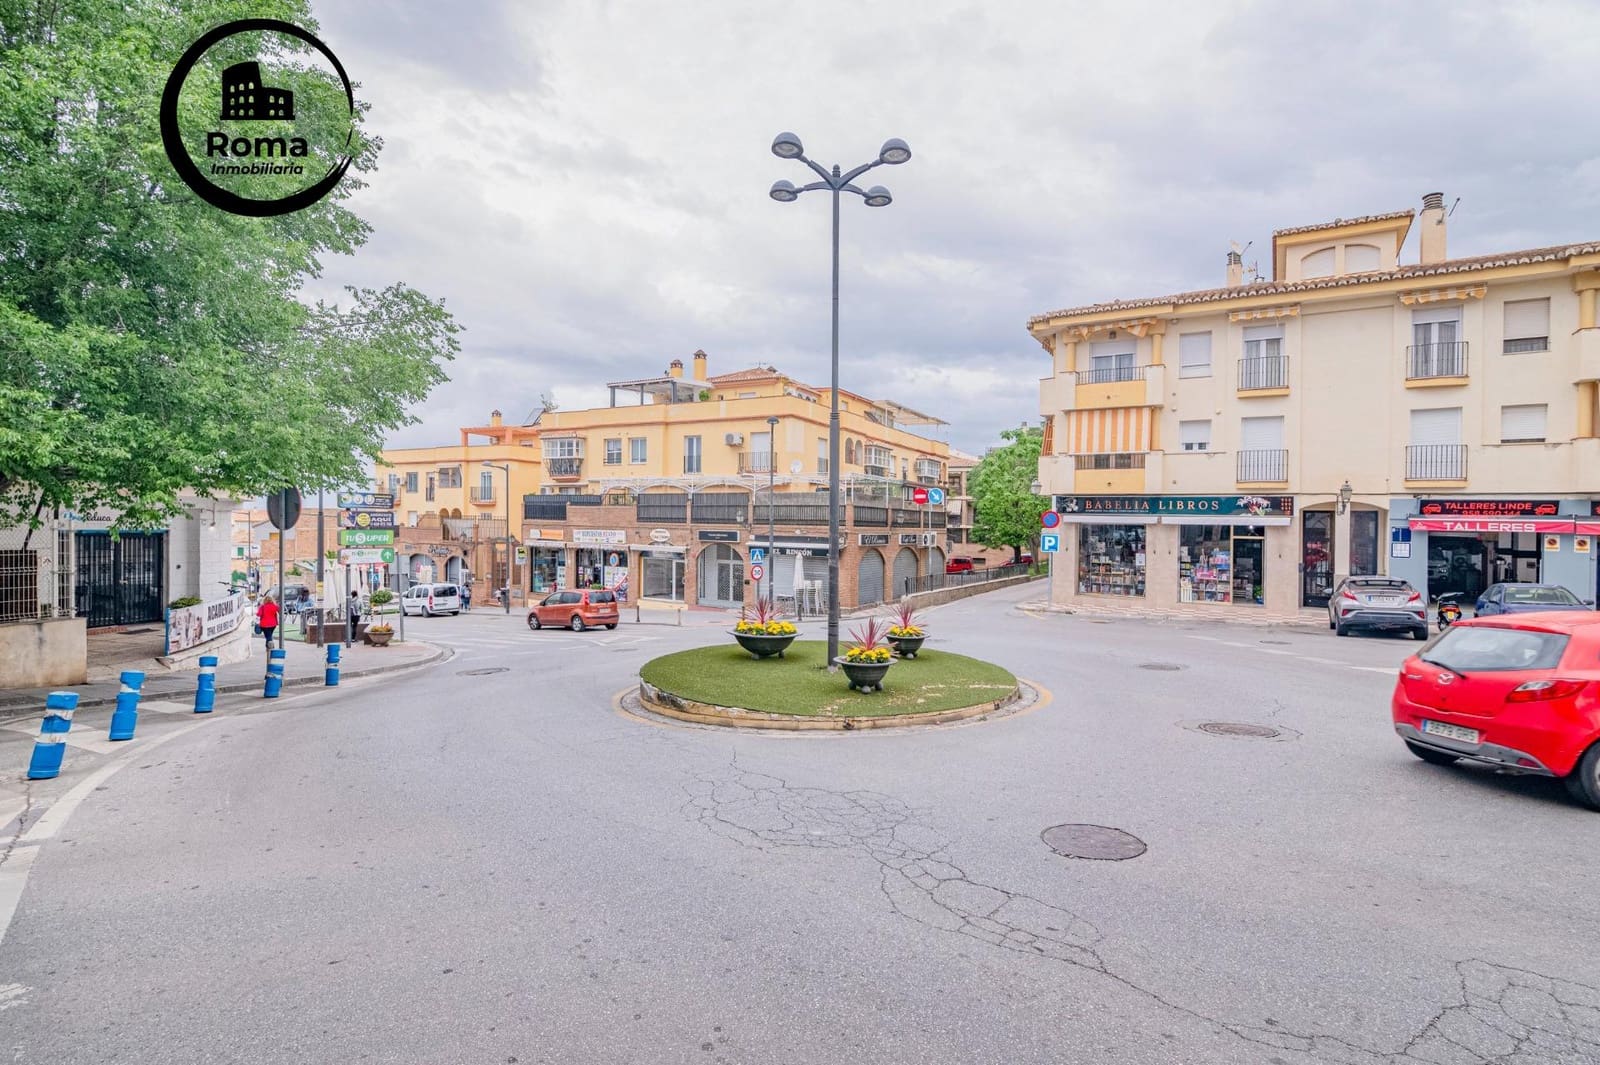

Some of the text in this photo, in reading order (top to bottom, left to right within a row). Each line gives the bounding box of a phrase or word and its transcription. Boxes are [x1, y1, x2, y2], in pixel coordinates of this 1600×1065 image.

[1085, 500, 1219, 510] BABELIA LIBROS
[1445, 502, 1496, 510] TALLERES
[1443, 522, 1536, 532] TALLERES
[1044, 537, 1056, 549] P
[207, 600, 234, 621] ACADEMIA
